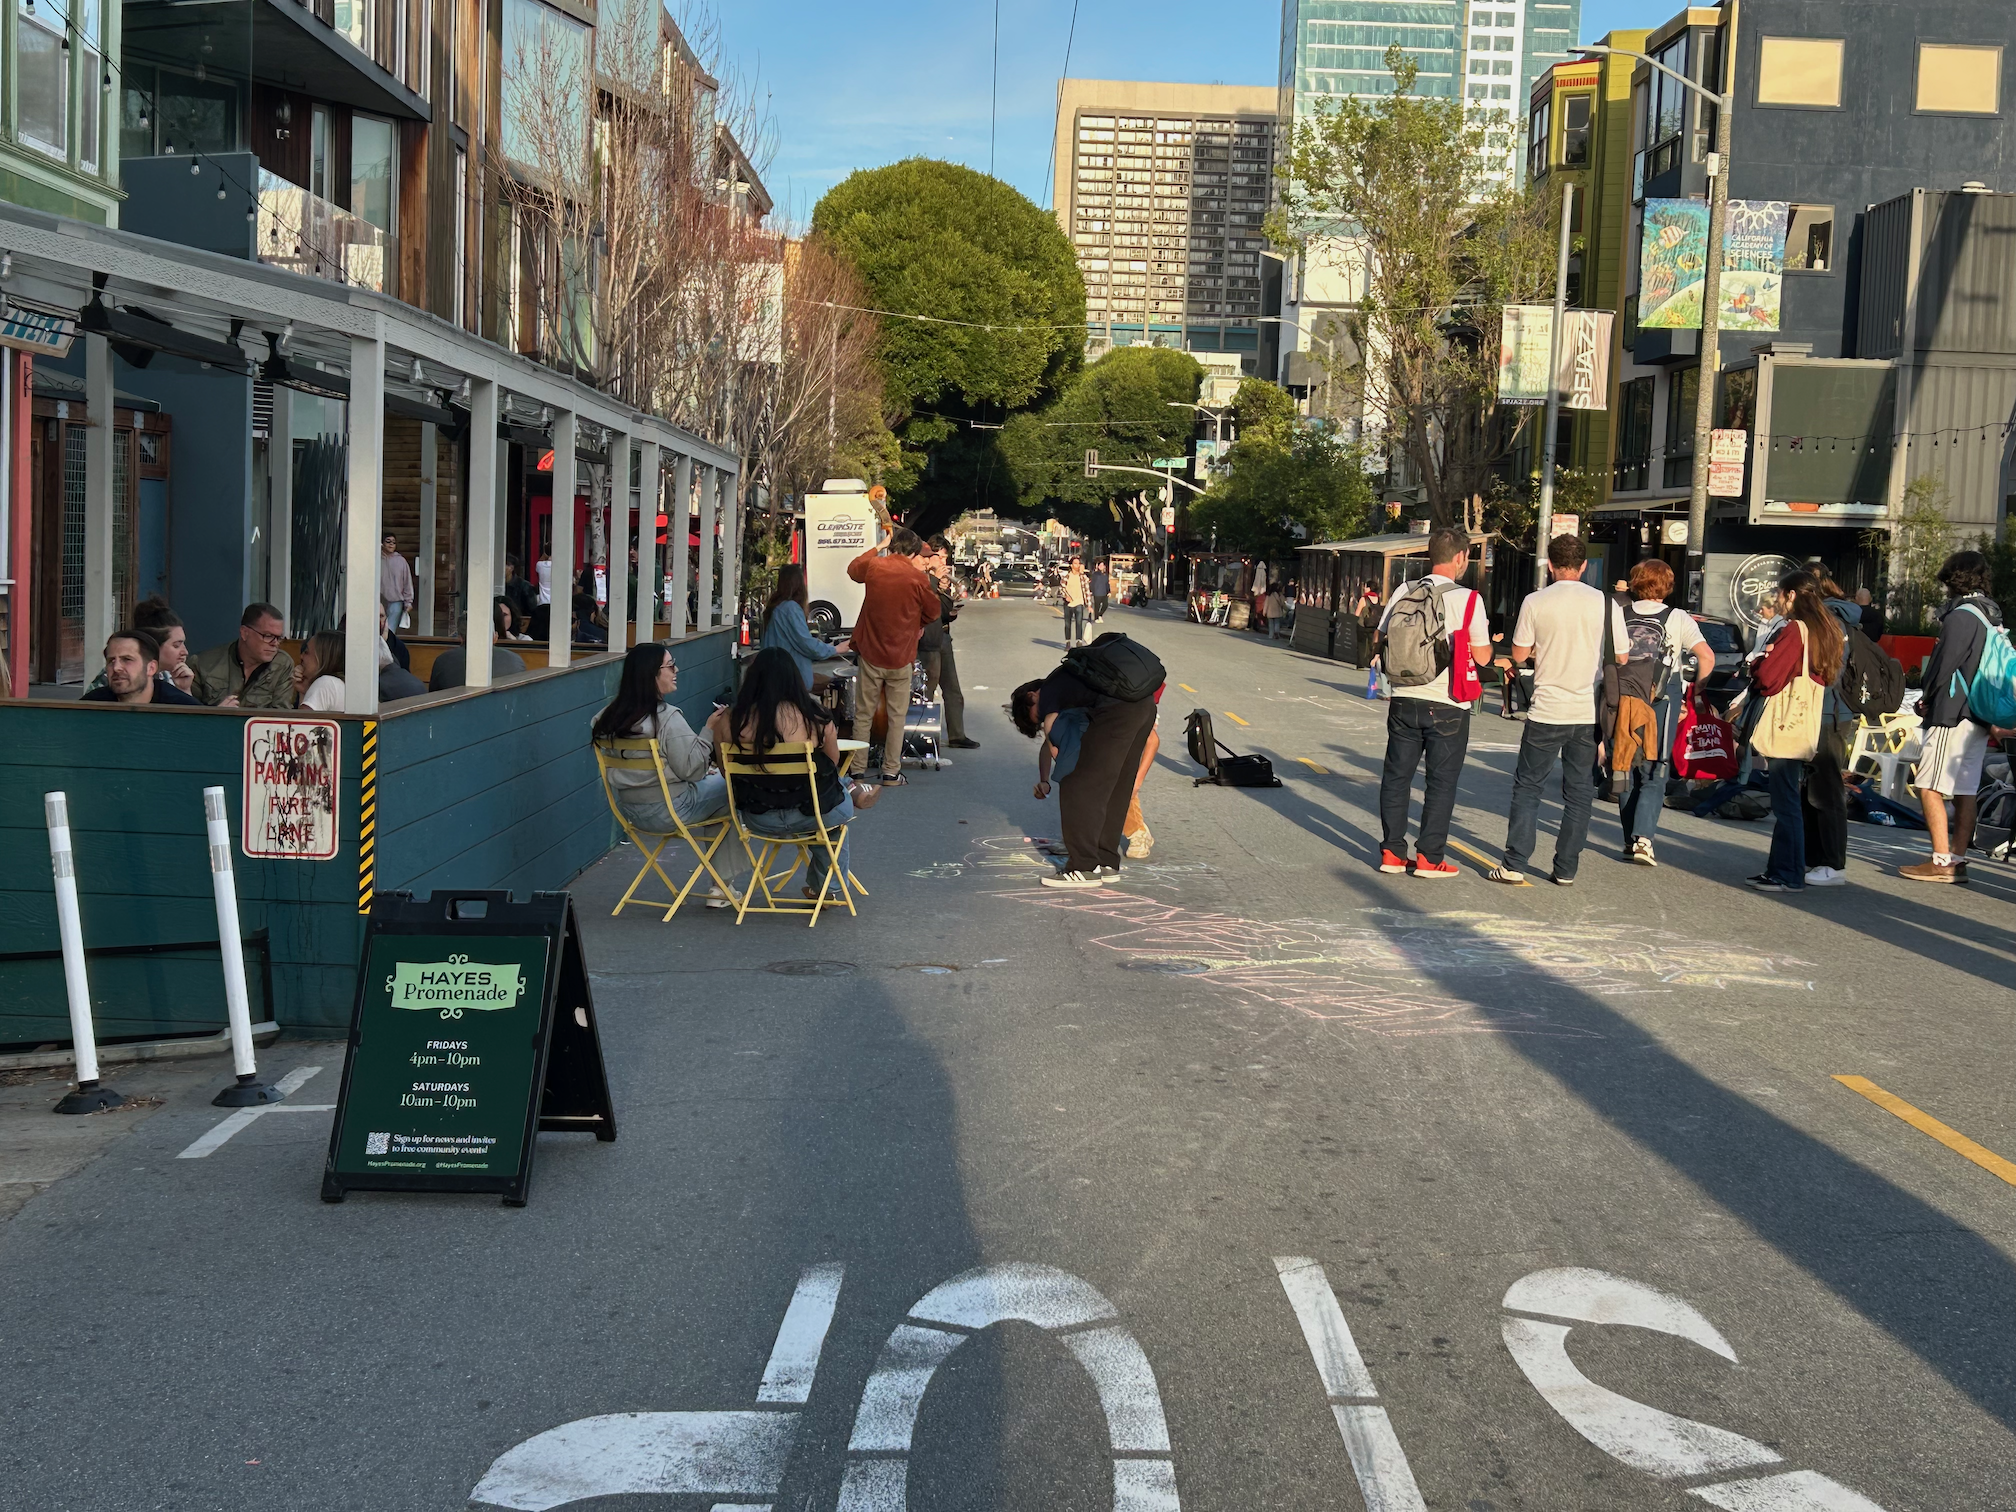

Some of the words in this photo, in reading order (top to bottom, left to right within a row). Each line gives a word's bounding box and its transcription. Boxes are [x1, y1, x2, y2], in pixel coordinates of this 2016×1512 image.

[1732, 234, 1773, 242] CALIFORNIA
[1730, 250, 1773, 258] SCIENCES
[1572, 310, 1599, 409] SFJAZZ
[275, 732, 309, 756] NO
[269, 797, 312, 816] FIRE
[266, 822, 315, 842] LANE
[420, 971, 492, 985] HAYES
[403, 983, 508, 1001] Promenade
[426, 1040, 468, 1050] FRIDAYS
[412, 1082, 470, 1092] SATURDAYS
[393, 1133, 411, 1145] Sign
[411, 1136, 422, 1145] up
[421, 1133, 435, 1145] for
[435, 1136, 455, 1144] news
[455, 1135, 471, 1144] and
[400, 1144, 416, 1152] free
[416, 1144, 460, 1155] community
